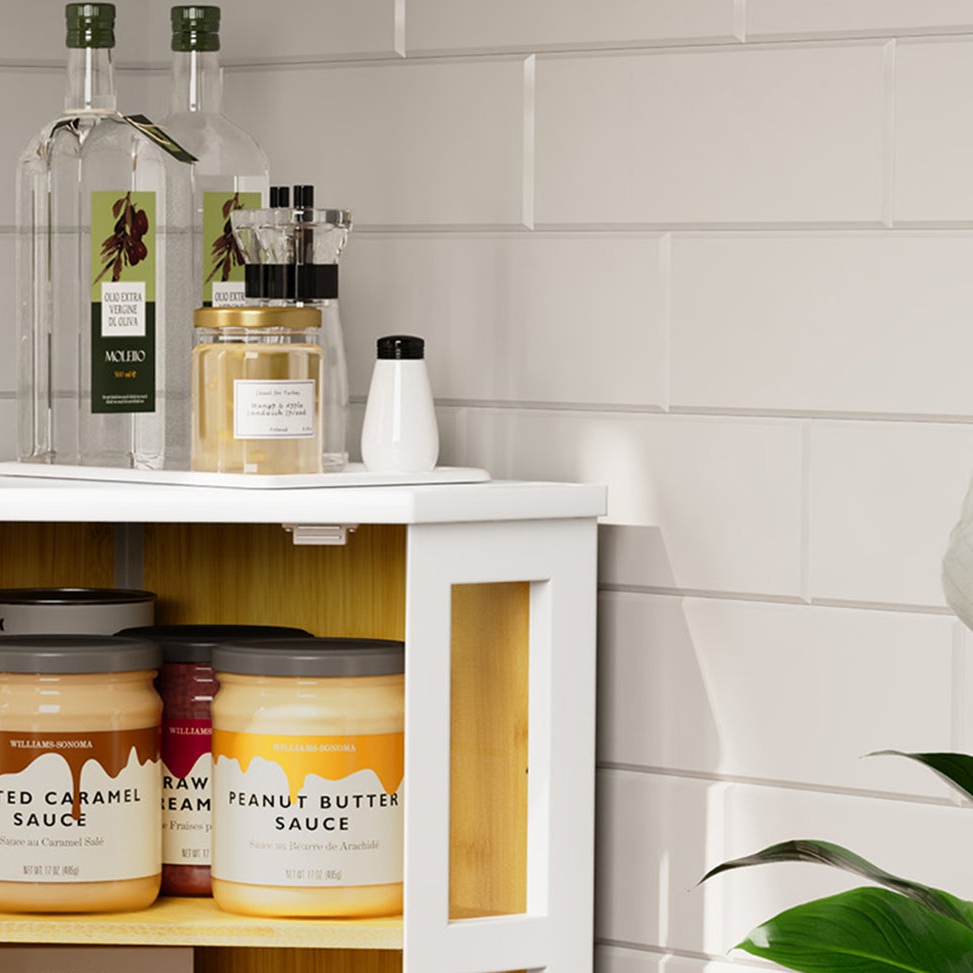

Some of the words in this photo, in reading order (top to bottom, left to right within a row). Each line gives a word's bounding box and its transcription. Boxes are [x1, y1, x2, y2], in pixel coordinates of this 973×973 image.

[121, 292, 143, 302] EXTRA
[10, 740, 93, 749] WILLIAMS-SONOMA
[272, 743, 356, 753] WILLIAMS-SONOMA
[44, 788, 141, 806] CARAMEL
[228, 790, 308, 809] PEANUT
[320, 793, 399, 809] BUTTER
[13, 812, 87, 827] SAUCE
[274, 816, 349, 832] SAUCE
[0, 836, 25, 847] Sauce
[27, 838, 39, 847] au
[41, 837, 83, 847] Caramel
[85, 836, 104, 847] Salé
